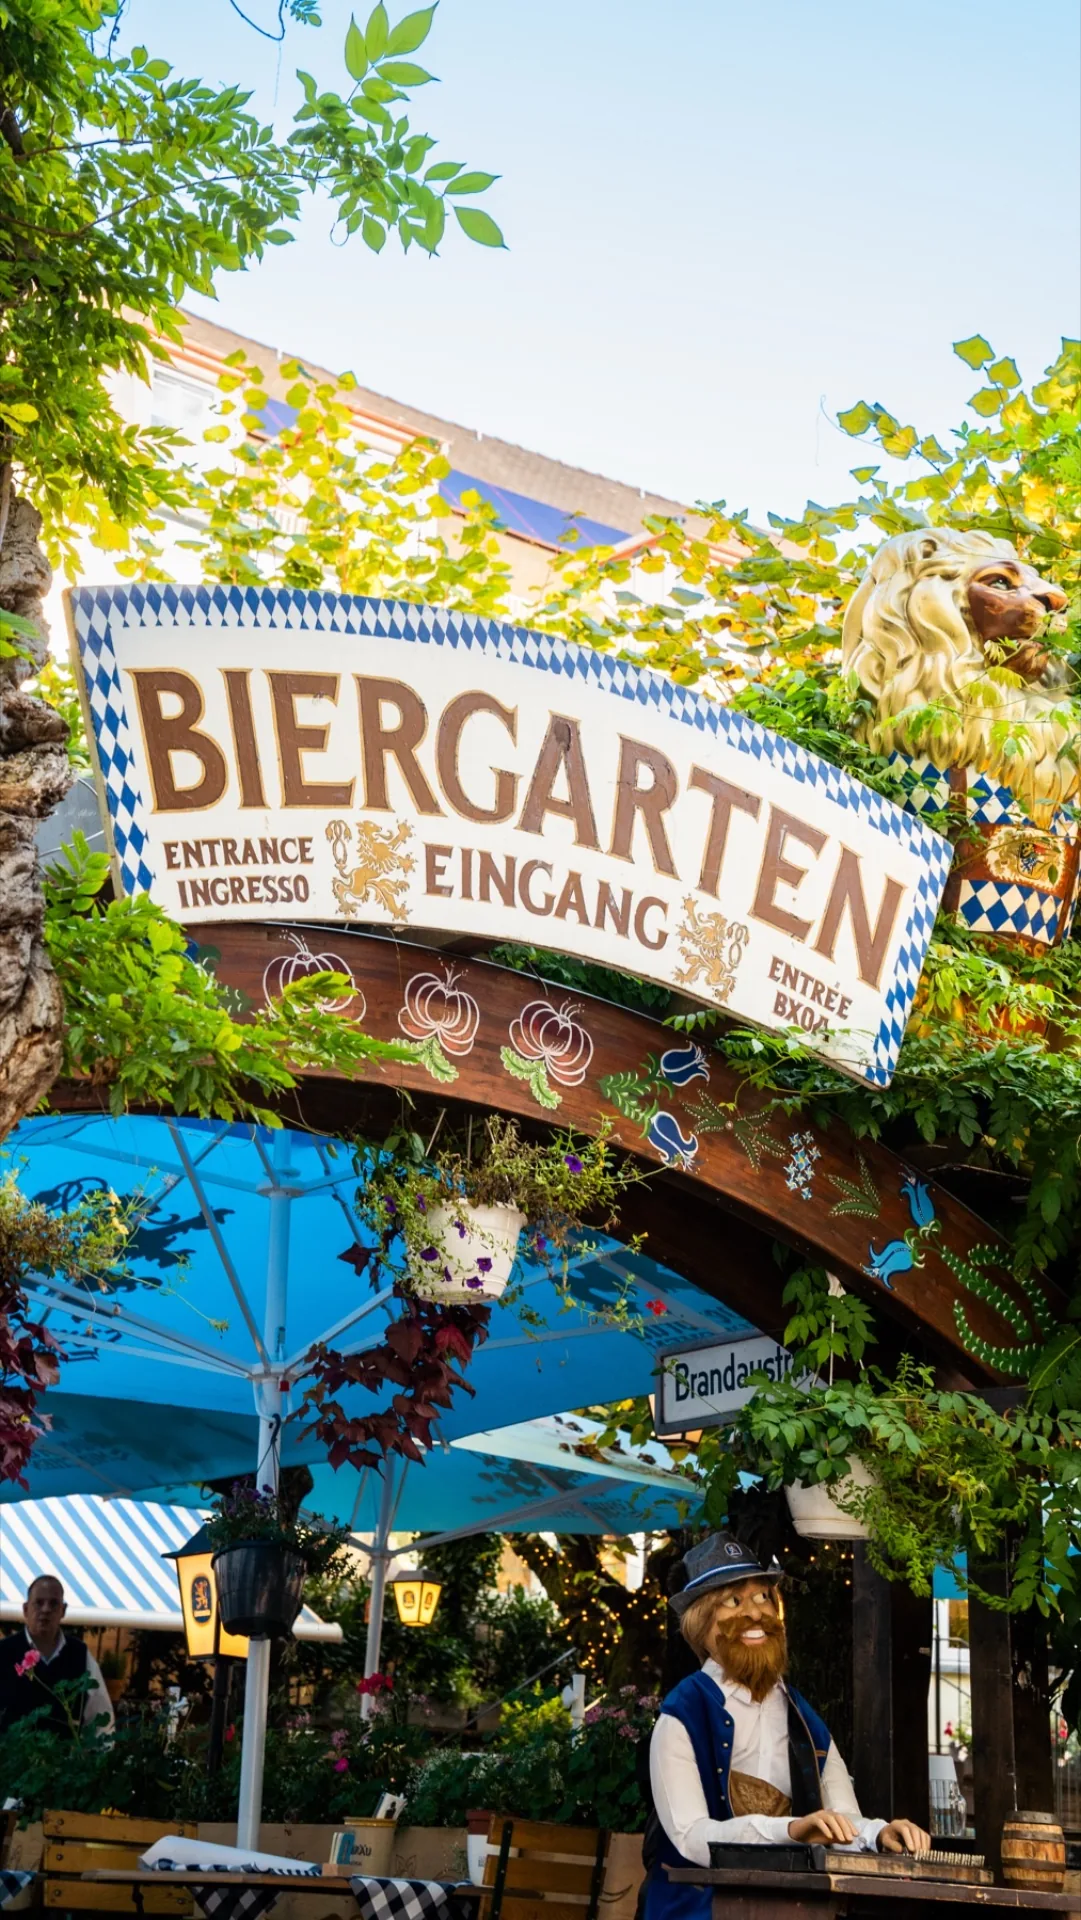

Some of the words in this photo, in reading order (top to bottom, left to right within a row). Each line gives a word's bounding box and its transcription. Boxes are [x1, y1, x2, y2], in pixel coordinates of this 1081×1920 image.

[123, 667, 908, 992] BIERGARTEN
[162, 837, 314, 870] ENTRANCE
[176, 875, 310, 909] INGRESSO
[422, 842, 669, 951] EINGANG
[767, 954, 853, 1020] ENTRÉE
[675, 1346, 808, 1402] Brandaustr
